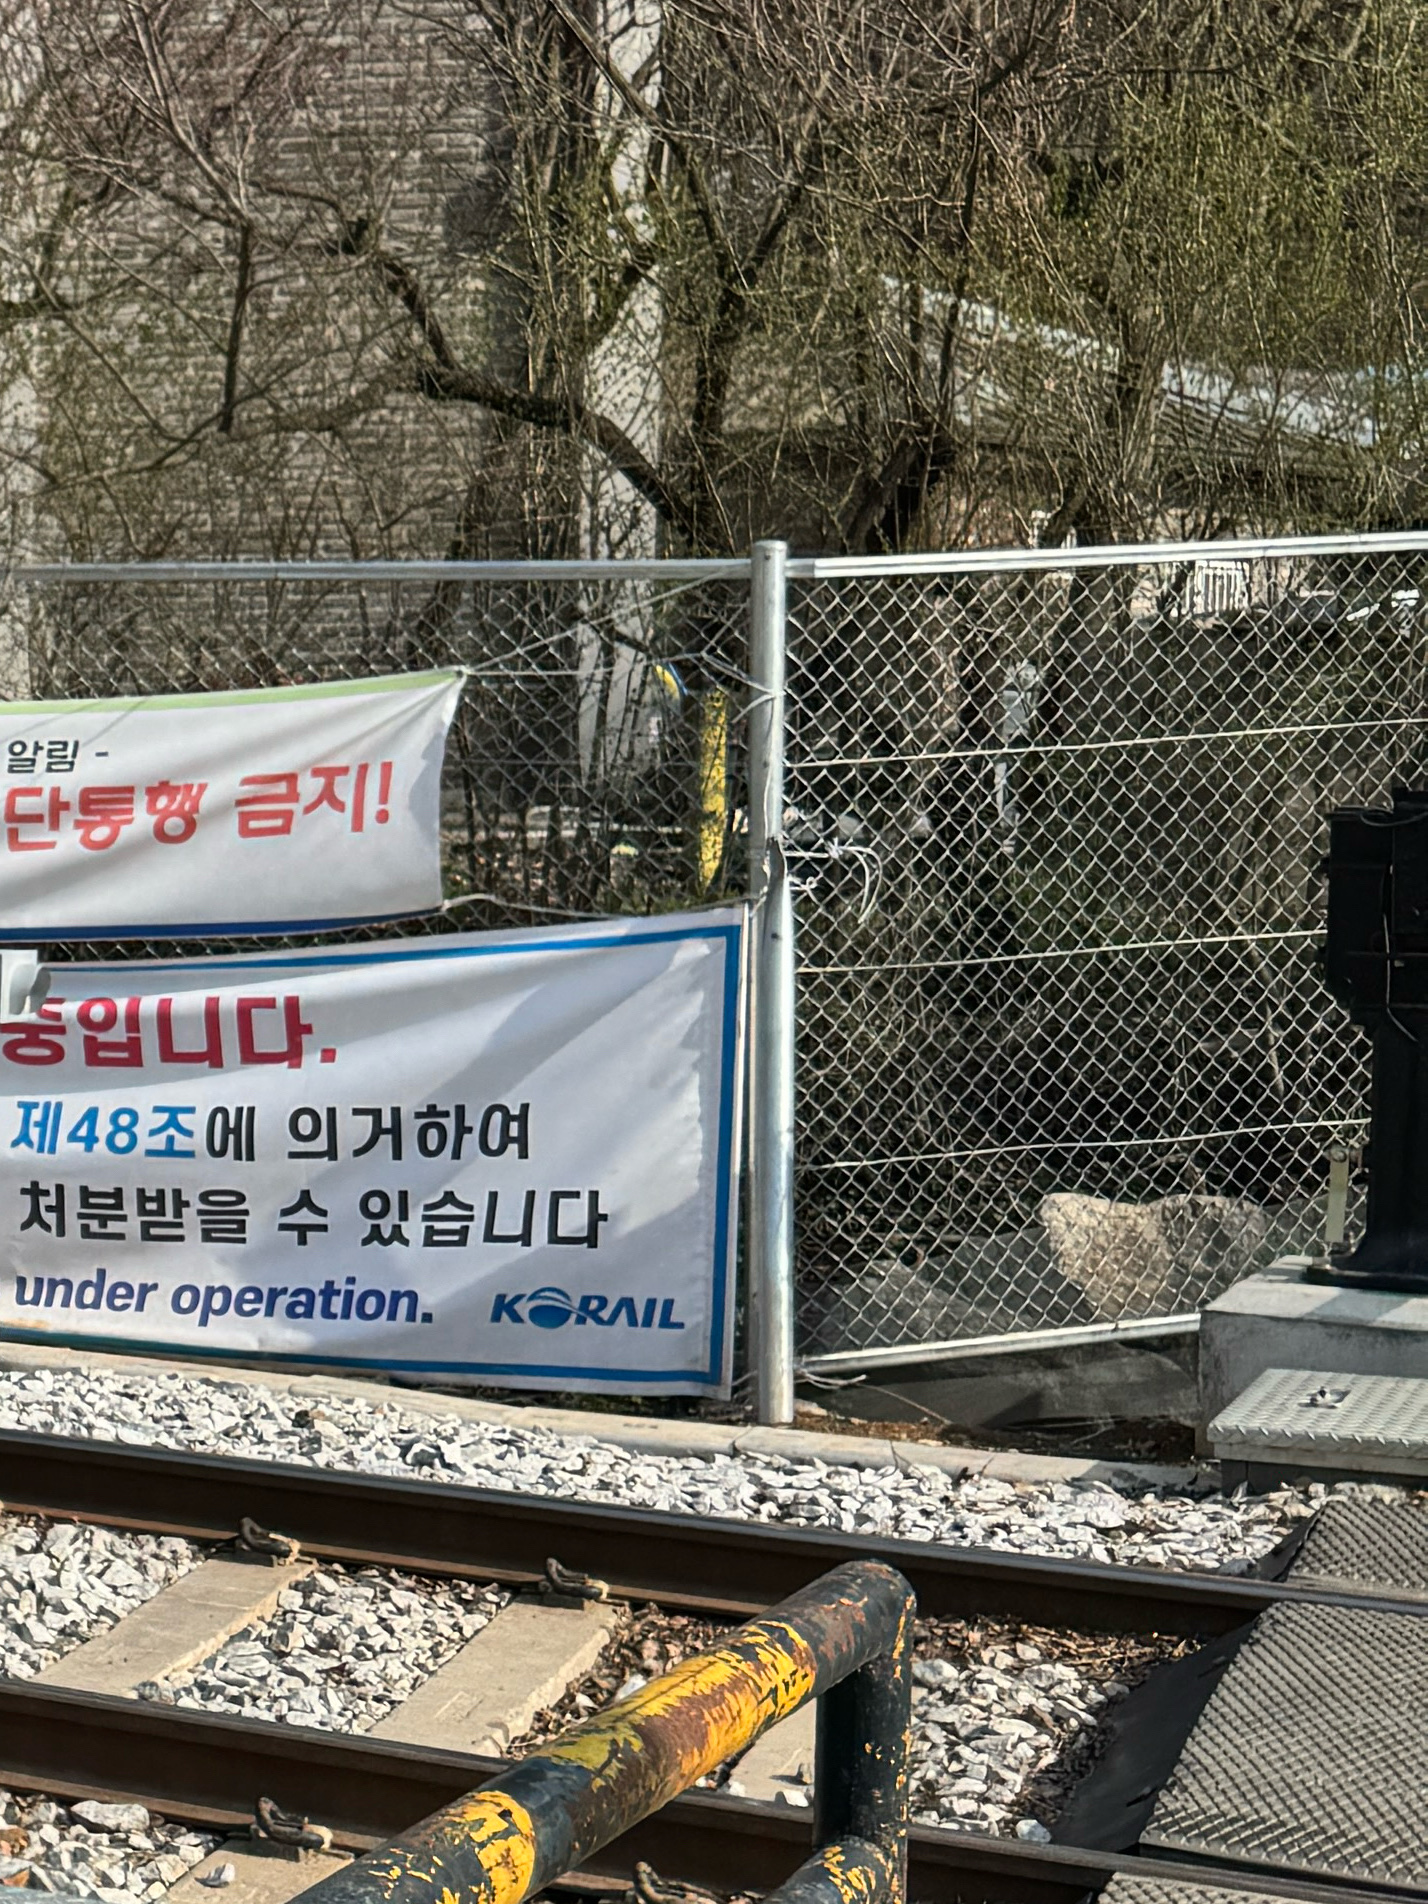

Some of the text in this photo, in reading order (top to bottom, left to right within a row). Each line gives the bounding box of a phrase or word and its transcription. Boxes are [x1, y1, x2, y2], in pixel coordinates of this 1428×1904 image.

[6, 739, 80, 773] 알림
[234, 760, 393, 839] 금지!
[9, 1099, 256, 1162] 제48조에
[287, 1102, 531, 1162] 의거하여
[19, 1177, 250, 1245] 처분받을
[277, 1188, 329, 1247] 수
[358, 1188, 609, 1249] 있습니다
[15, 1267, 159, 1313] under
[169, 1275, 434, 1328] operation.
